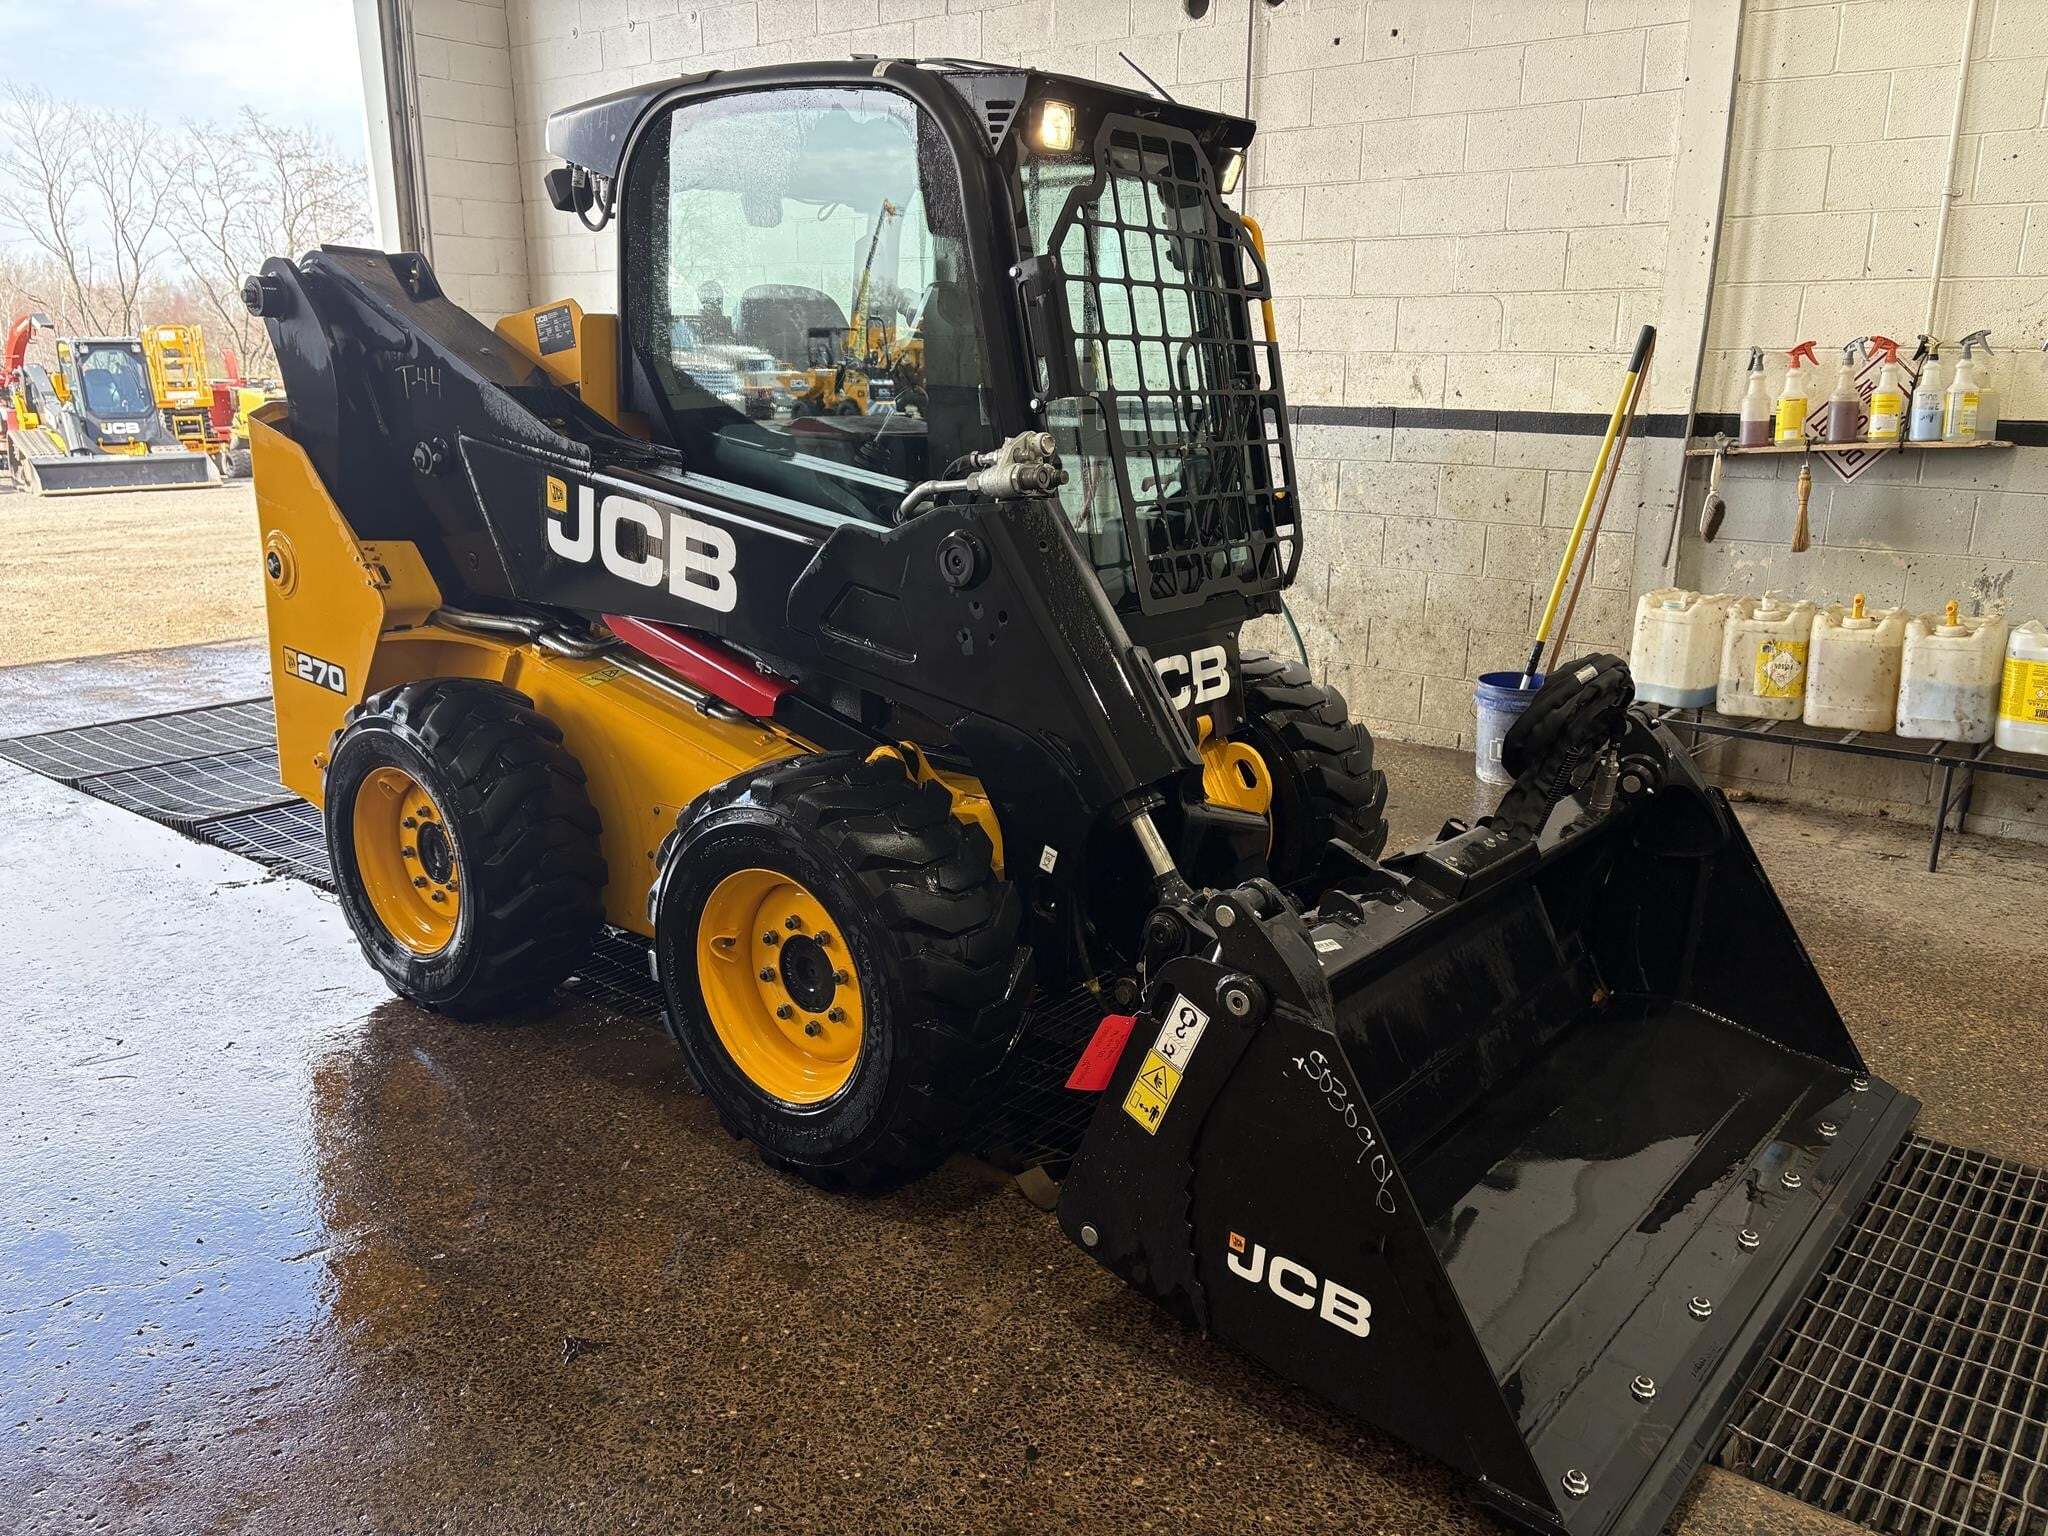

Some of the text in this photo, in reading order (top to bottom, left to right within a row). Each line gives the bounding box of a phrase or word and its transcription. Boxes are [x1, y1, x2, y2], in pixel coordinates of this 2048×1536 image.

[394, 364, 441, 398] T-44
[101, 422, 140, 434] JCB
[547, 485, 738, 613] JCB
[298, 653, 345, 692] 270
[1153, 645, 1231, 710] CB
[1227, 1243, 1372, 1338] JCB
